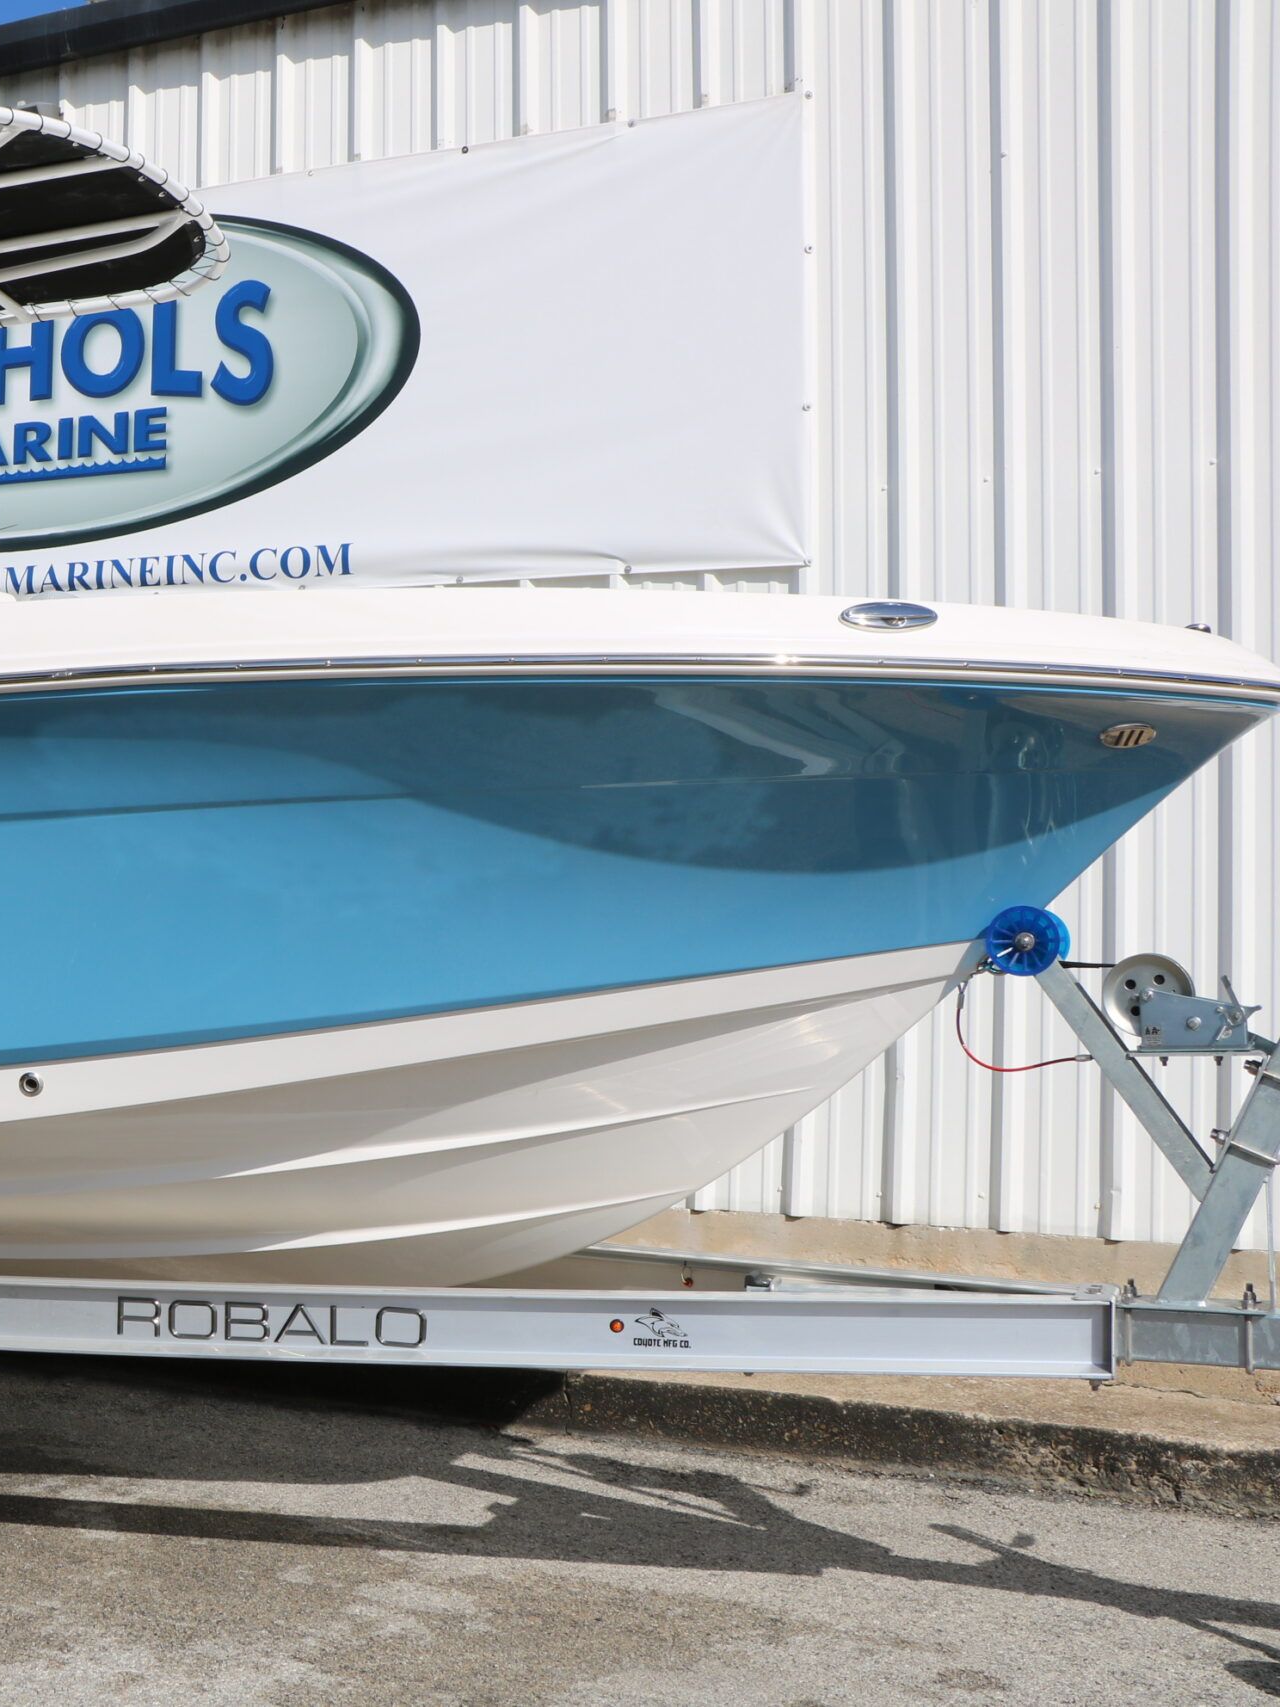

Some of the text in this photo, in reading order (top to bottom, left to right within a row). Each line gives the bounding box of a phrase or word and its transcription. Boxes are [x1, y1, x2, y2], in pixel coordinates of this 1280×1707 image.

[116, 1295, 428, 1349] ROBALO
[633, 1337, 662, 1348] COYOTE
[663, 1338, 678, 1349] MFG
